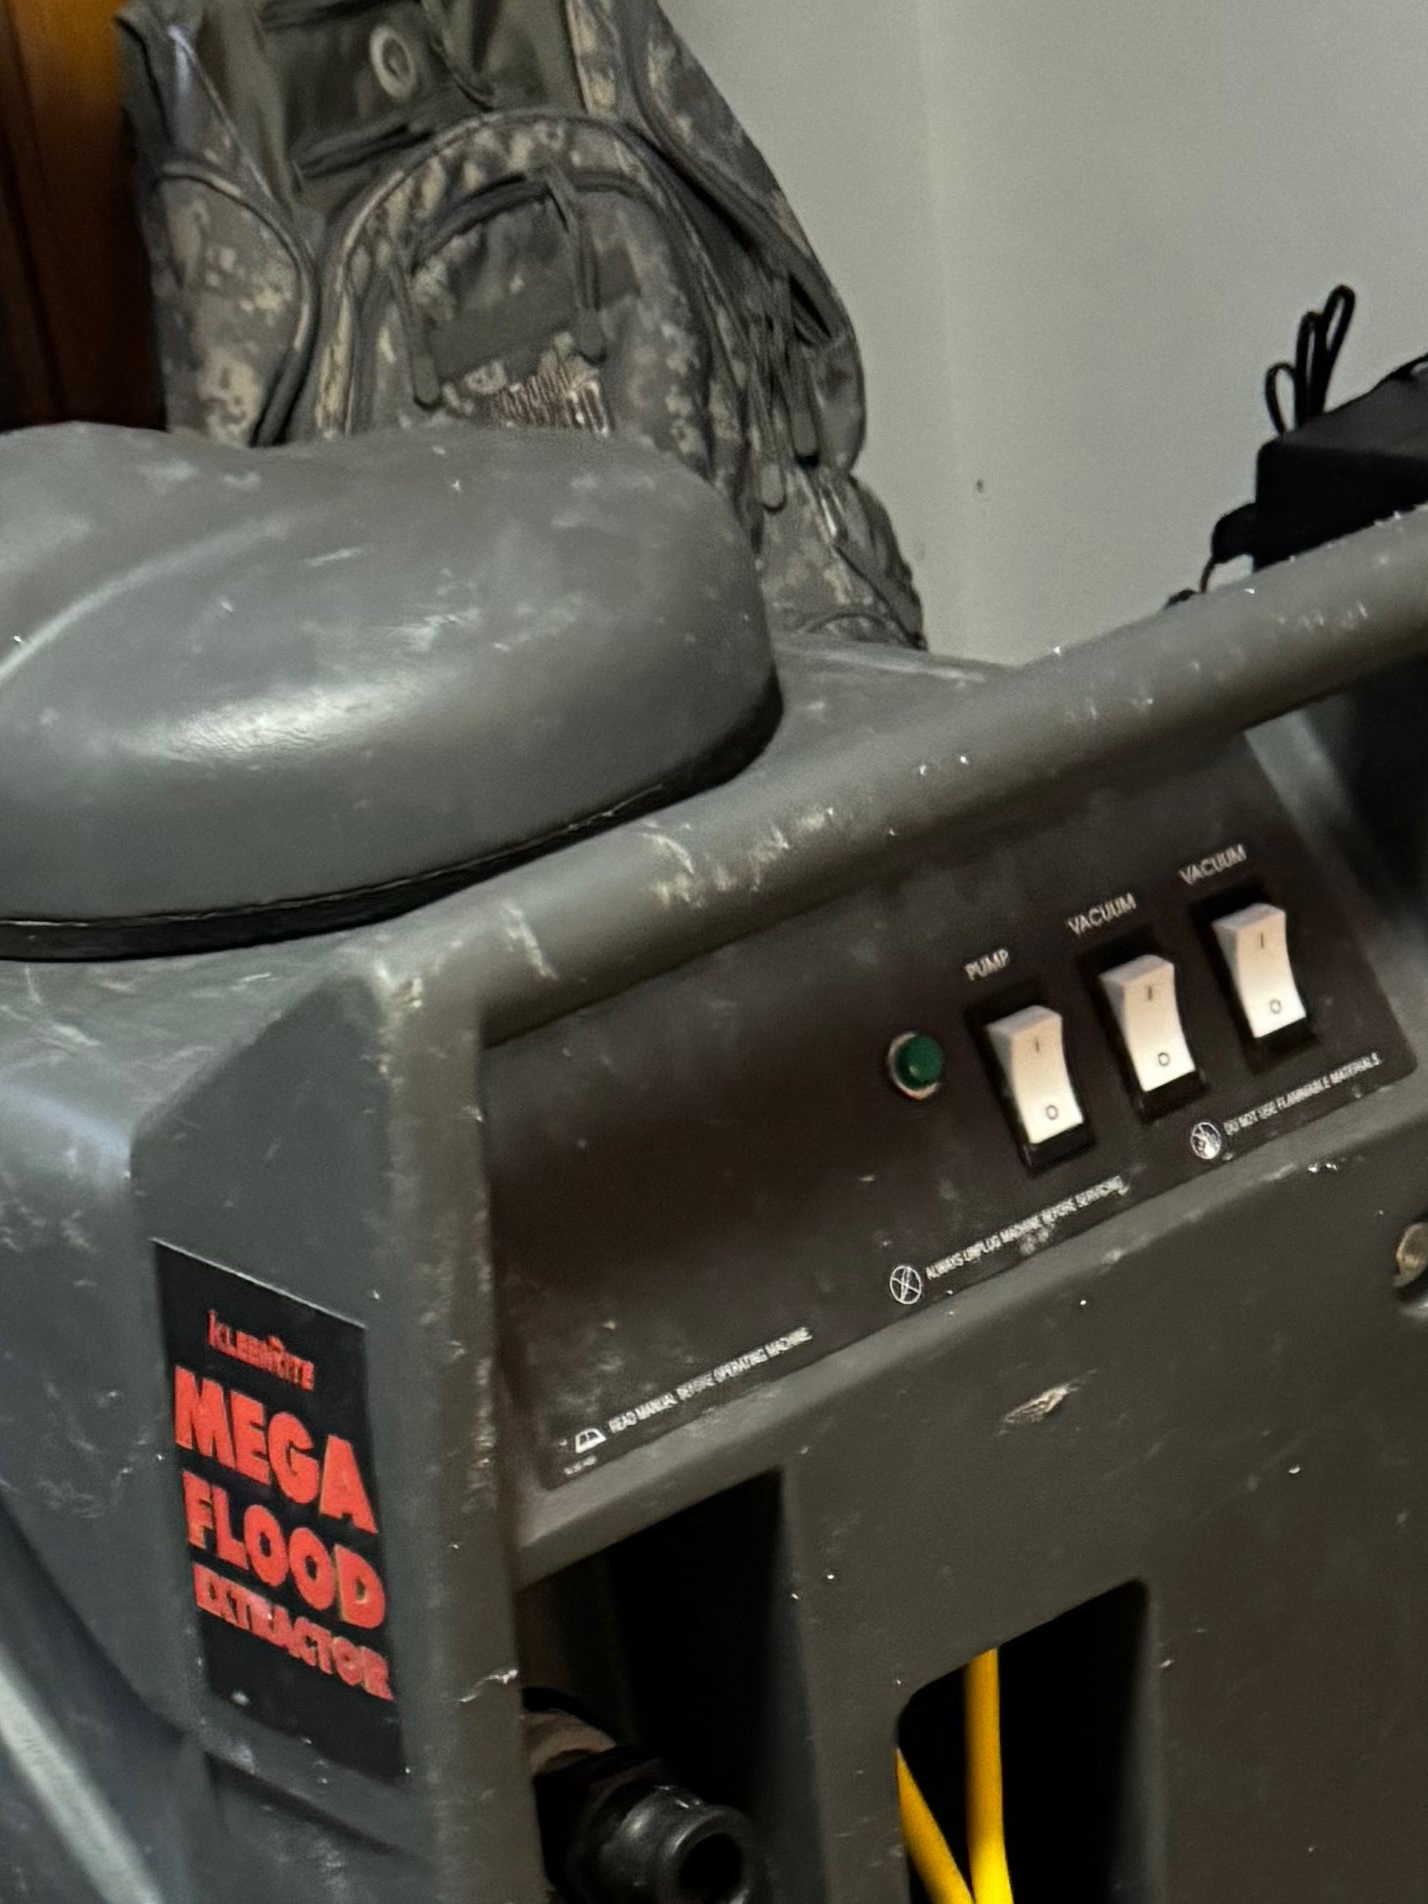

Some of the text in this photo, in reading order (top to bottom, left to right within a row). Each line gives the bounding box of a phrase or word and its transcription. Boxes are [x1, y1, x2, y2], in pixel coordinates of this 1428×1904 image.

[1179, 844, 1247, 886] VACUUM
[1068, 892, 1137, 936] VACUUM
[964, 948, 1010, 981] PUMP
[1238, 1110, 1258, 1128] NOT
[175, 1365, 379, 1534] MEGA
[182, 1470, 386, 1630] FLOOD
[192, 1562, 395, 1702] EXTRACTOR
